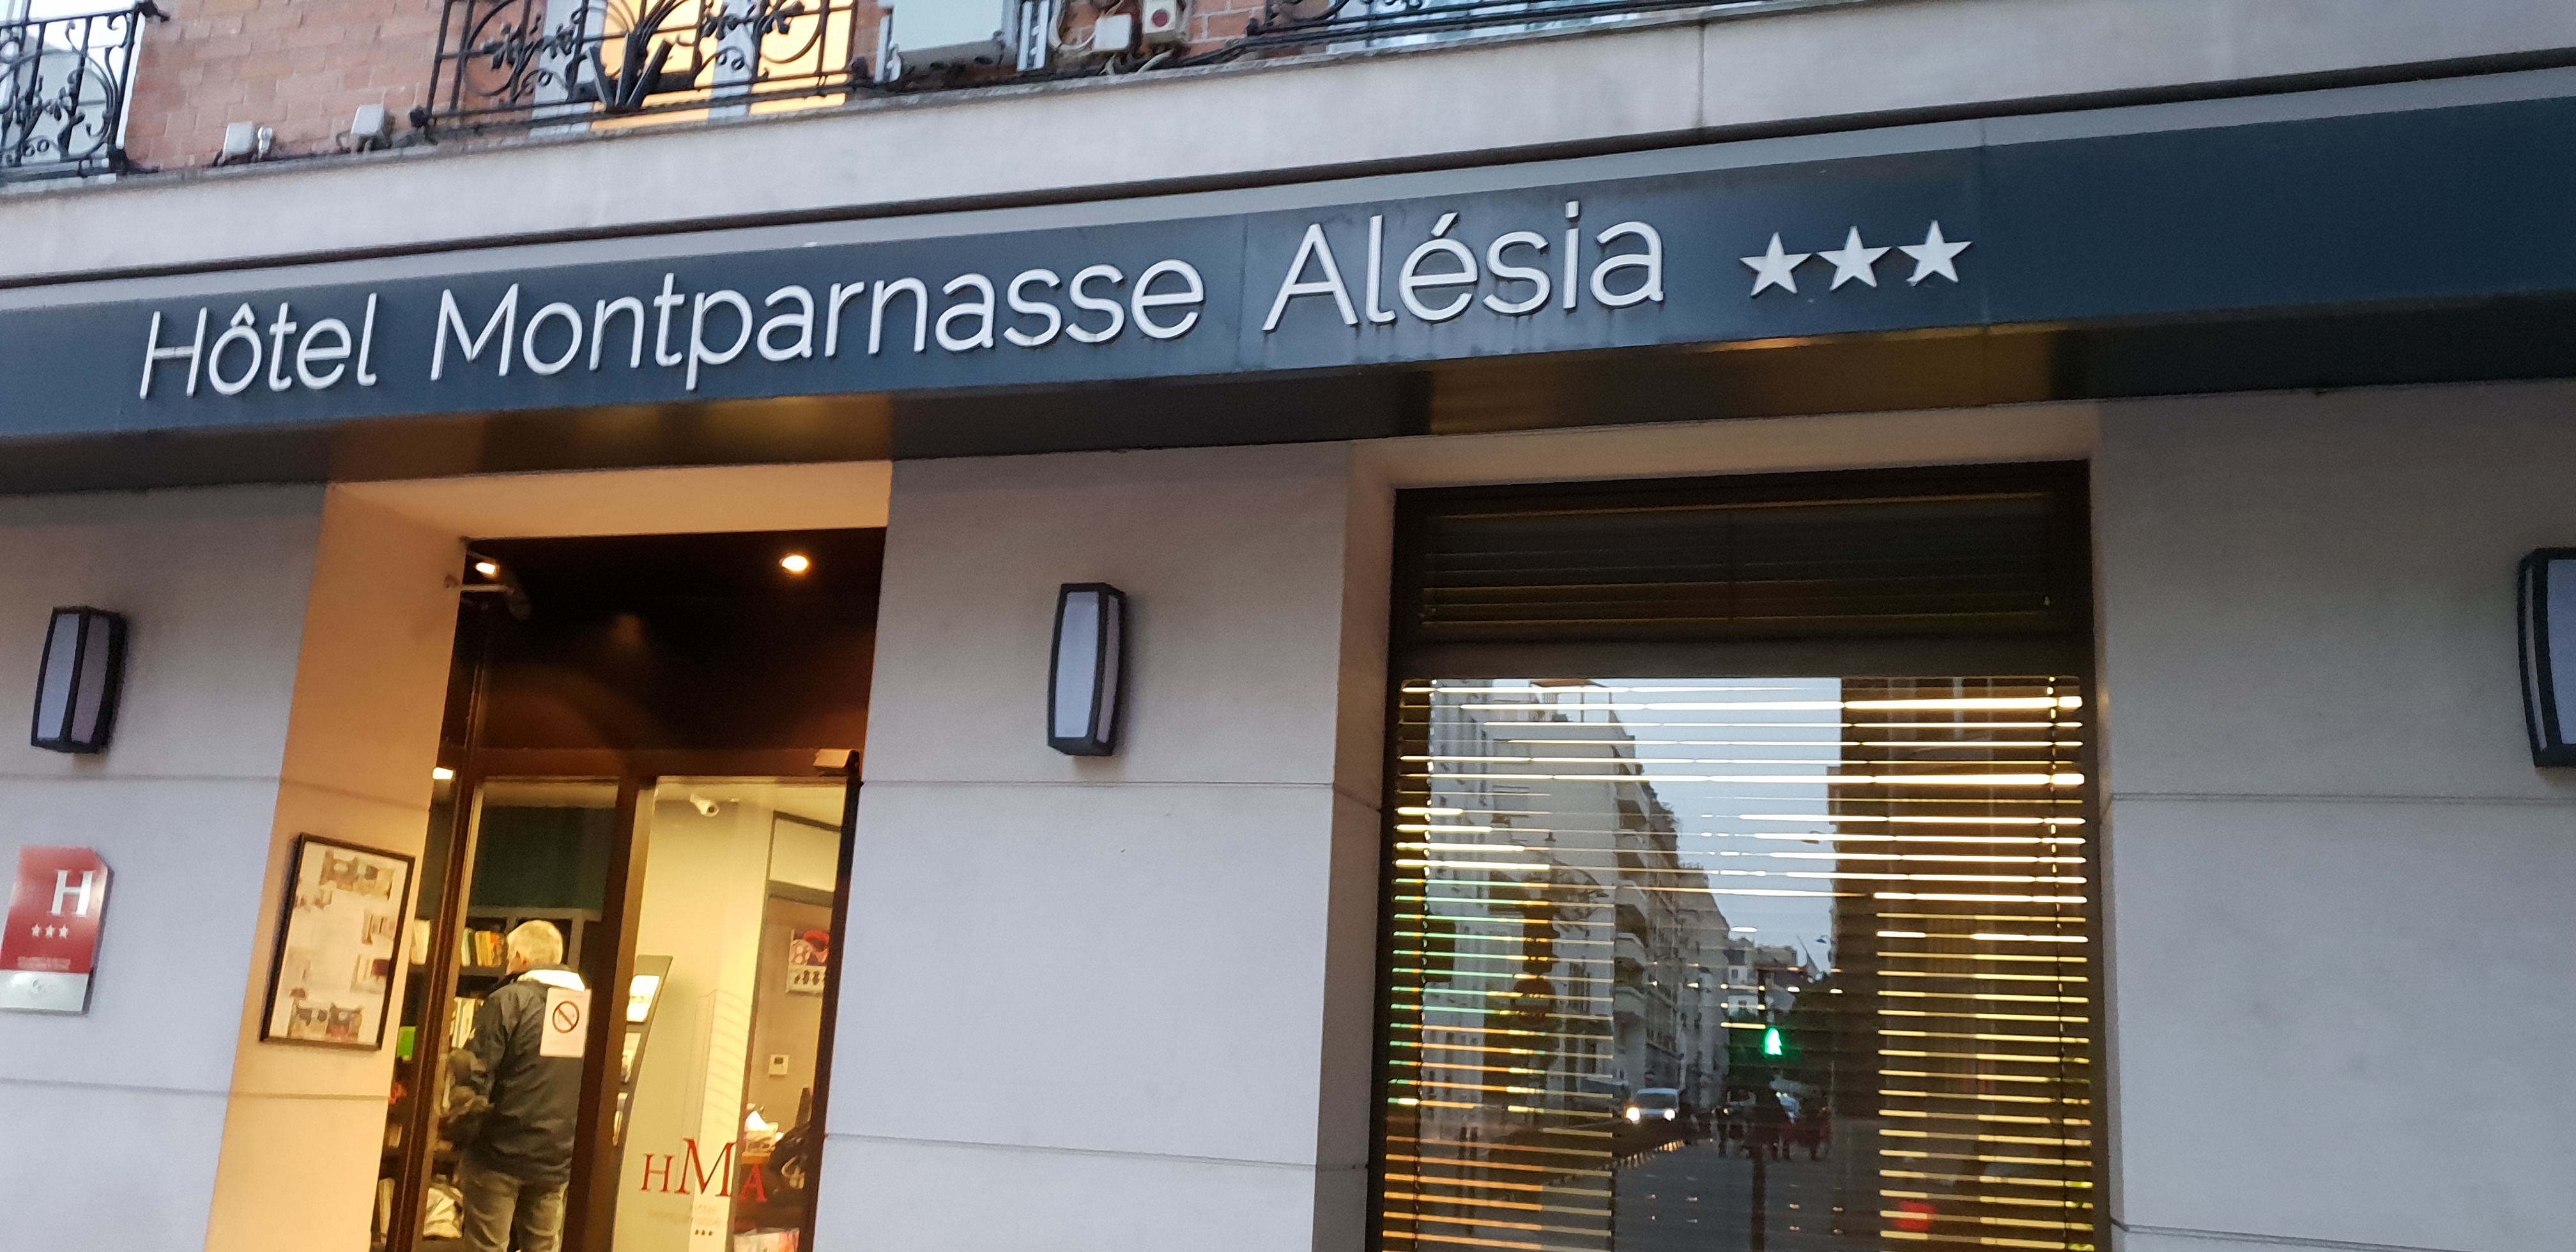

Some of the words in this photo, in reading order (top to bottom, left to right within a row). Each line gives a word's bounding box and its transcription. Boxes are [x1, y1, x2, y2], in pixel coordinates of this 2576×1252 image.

[139, 293, 378, 399] Hôtel
[431, 259, 1204, 391] Montparnasse
[1262, 201, 1664, 332] Alésia
[49, 869, 94, 917] H
[640, 1137, 769, 1203] HMA
